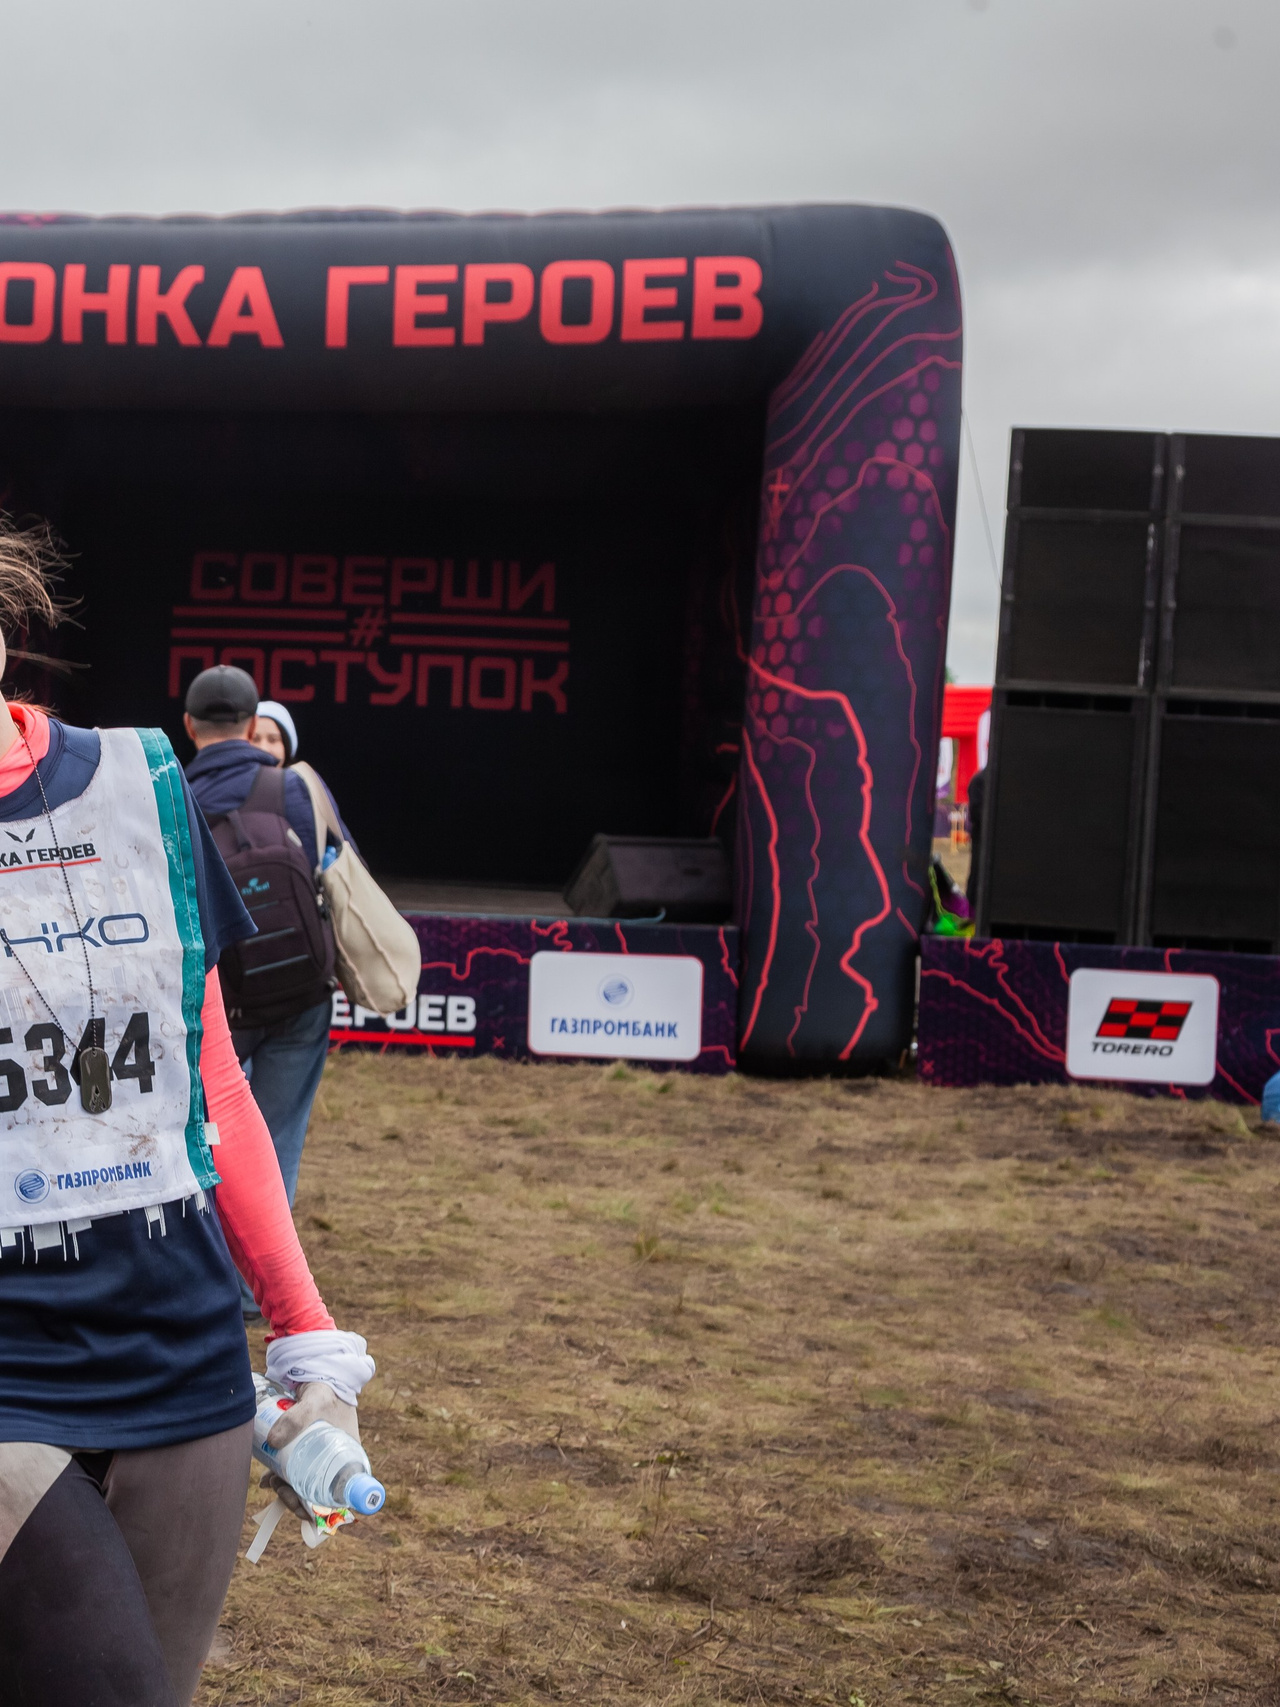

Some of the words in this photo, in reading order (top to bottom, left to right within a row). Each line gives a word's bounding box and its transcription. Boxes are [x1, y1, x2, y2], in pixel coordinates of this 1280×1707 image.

[324, 256, 764, 348] ГЕРОЕВ
[190, 551, 557, 614] СОВЕРШИ
[168, 646, 570, 714] ПОСТУПОК
[26, 842, 96, 864] ГЕРОЕВ
[550, 1017, 679, 1039] ГАЗПРОМБАНК
[1091, 1041, 1174, 1057] TORERO
[56, 1161, 152, 1191] ГАЗПРОМБАНК
